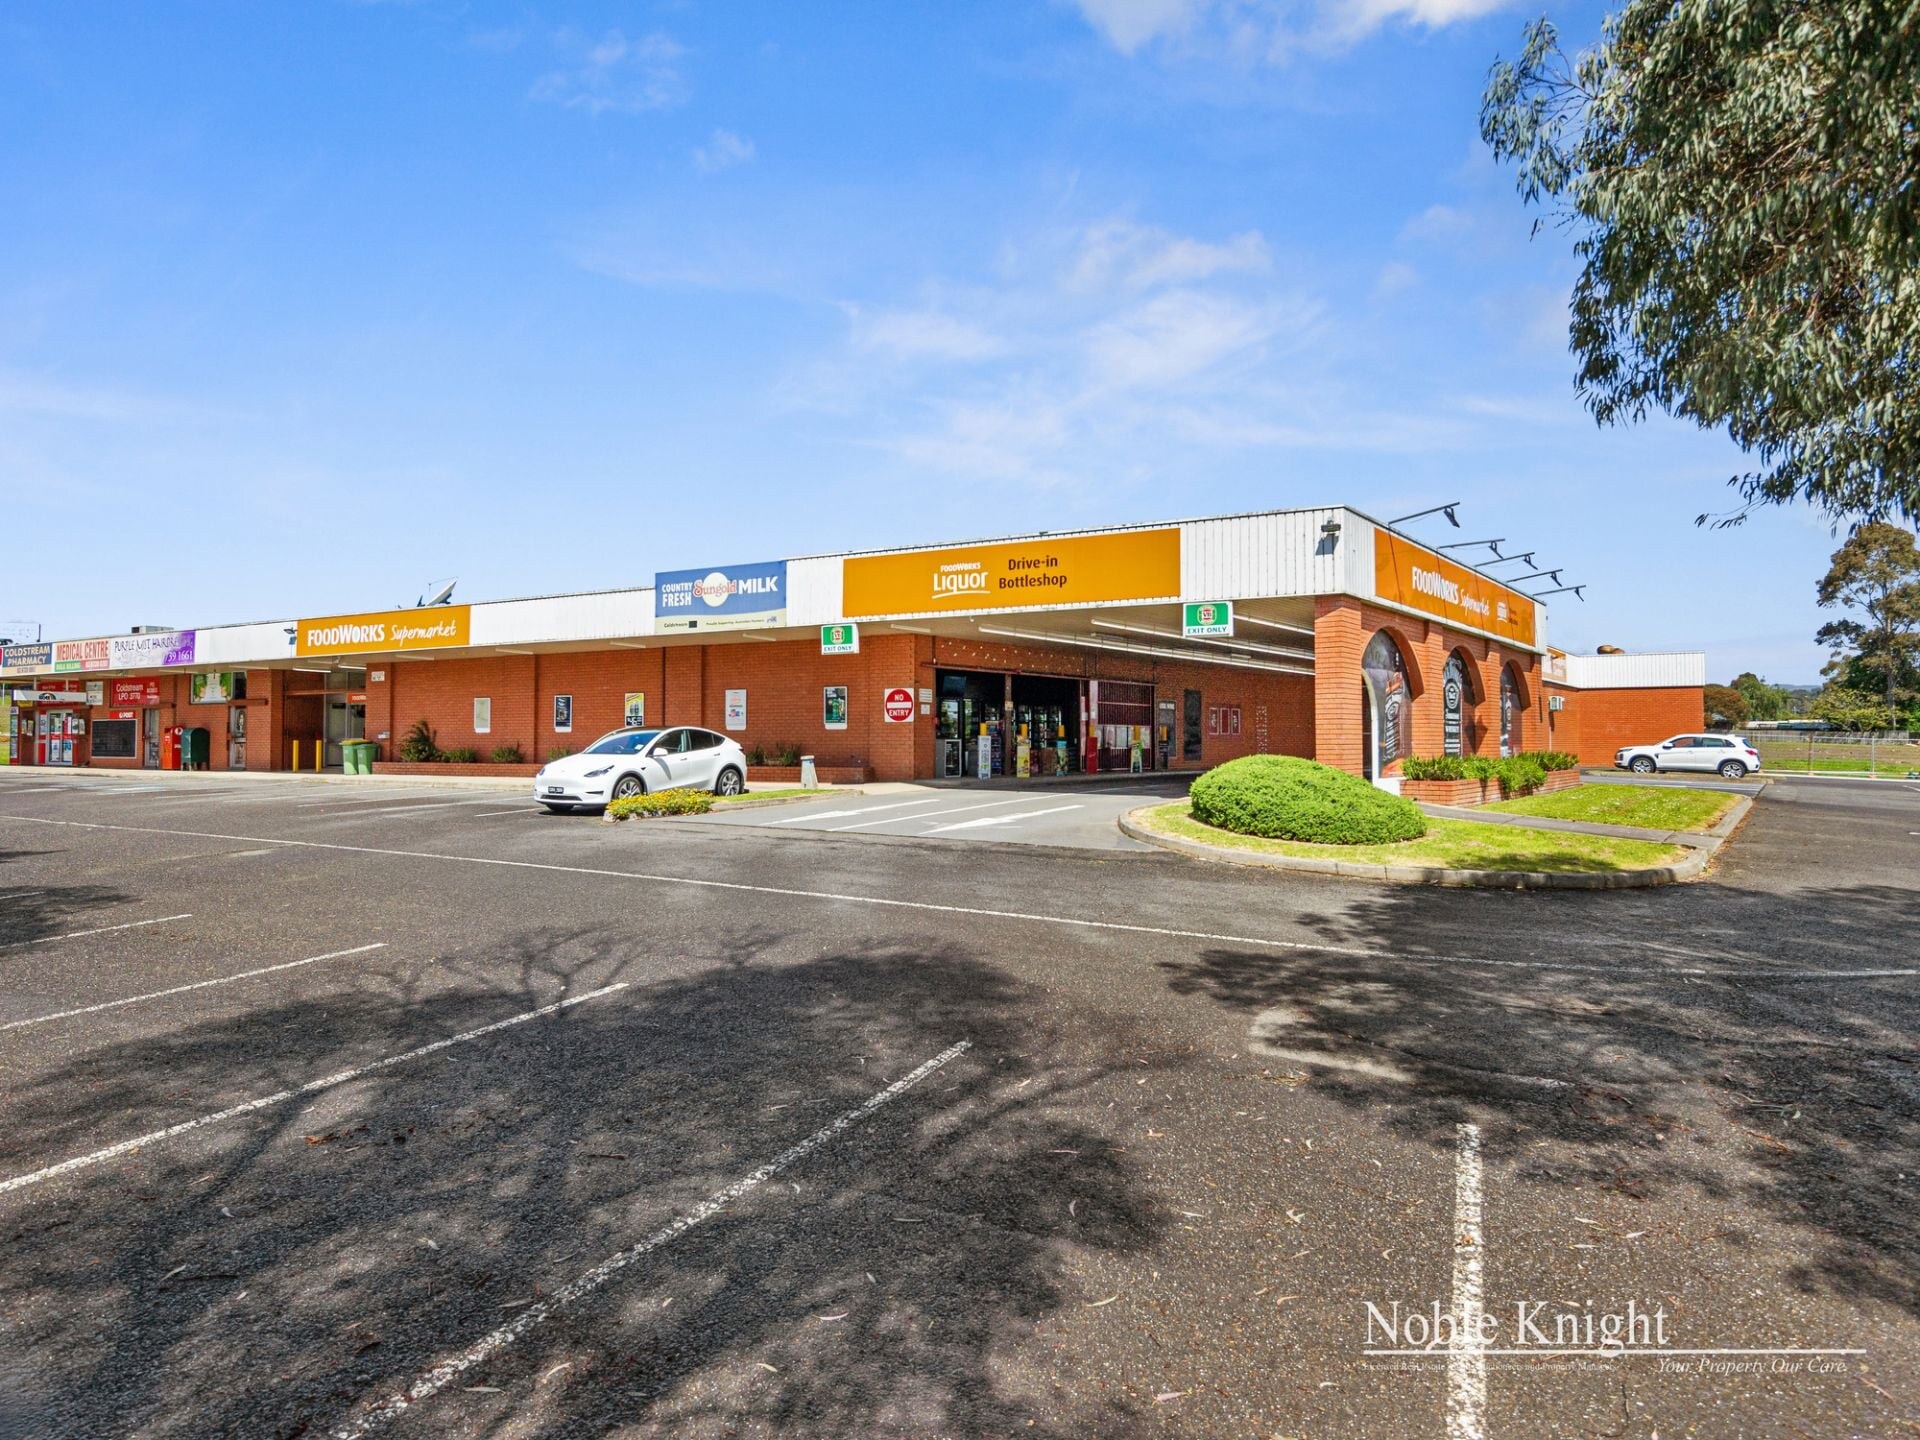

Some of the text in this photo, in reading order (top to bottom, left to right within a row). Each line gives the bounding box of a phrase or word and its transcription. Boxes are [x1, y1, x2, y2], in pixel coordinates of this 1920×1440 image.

[1008, 555, 1058, 570] Drive-in
[661, 582, 693, 593] COUNTRY
[692, 576, 779, 598] Sungold MILK
[933, 571, 988, 592] Liquor
[998, 573, 1067, 588] Bottleshop
[662, 592, 692, 608] FRESH
[390, 620, 457, 647] Supermarket
[4, 645, 51, 657] COLDSTREAM
[56, 641, 109, 661] MEDICAL CENTRE
[7, 656, 47, 667] PHARMACY
[888, 709, 909, 717] ENTRY
